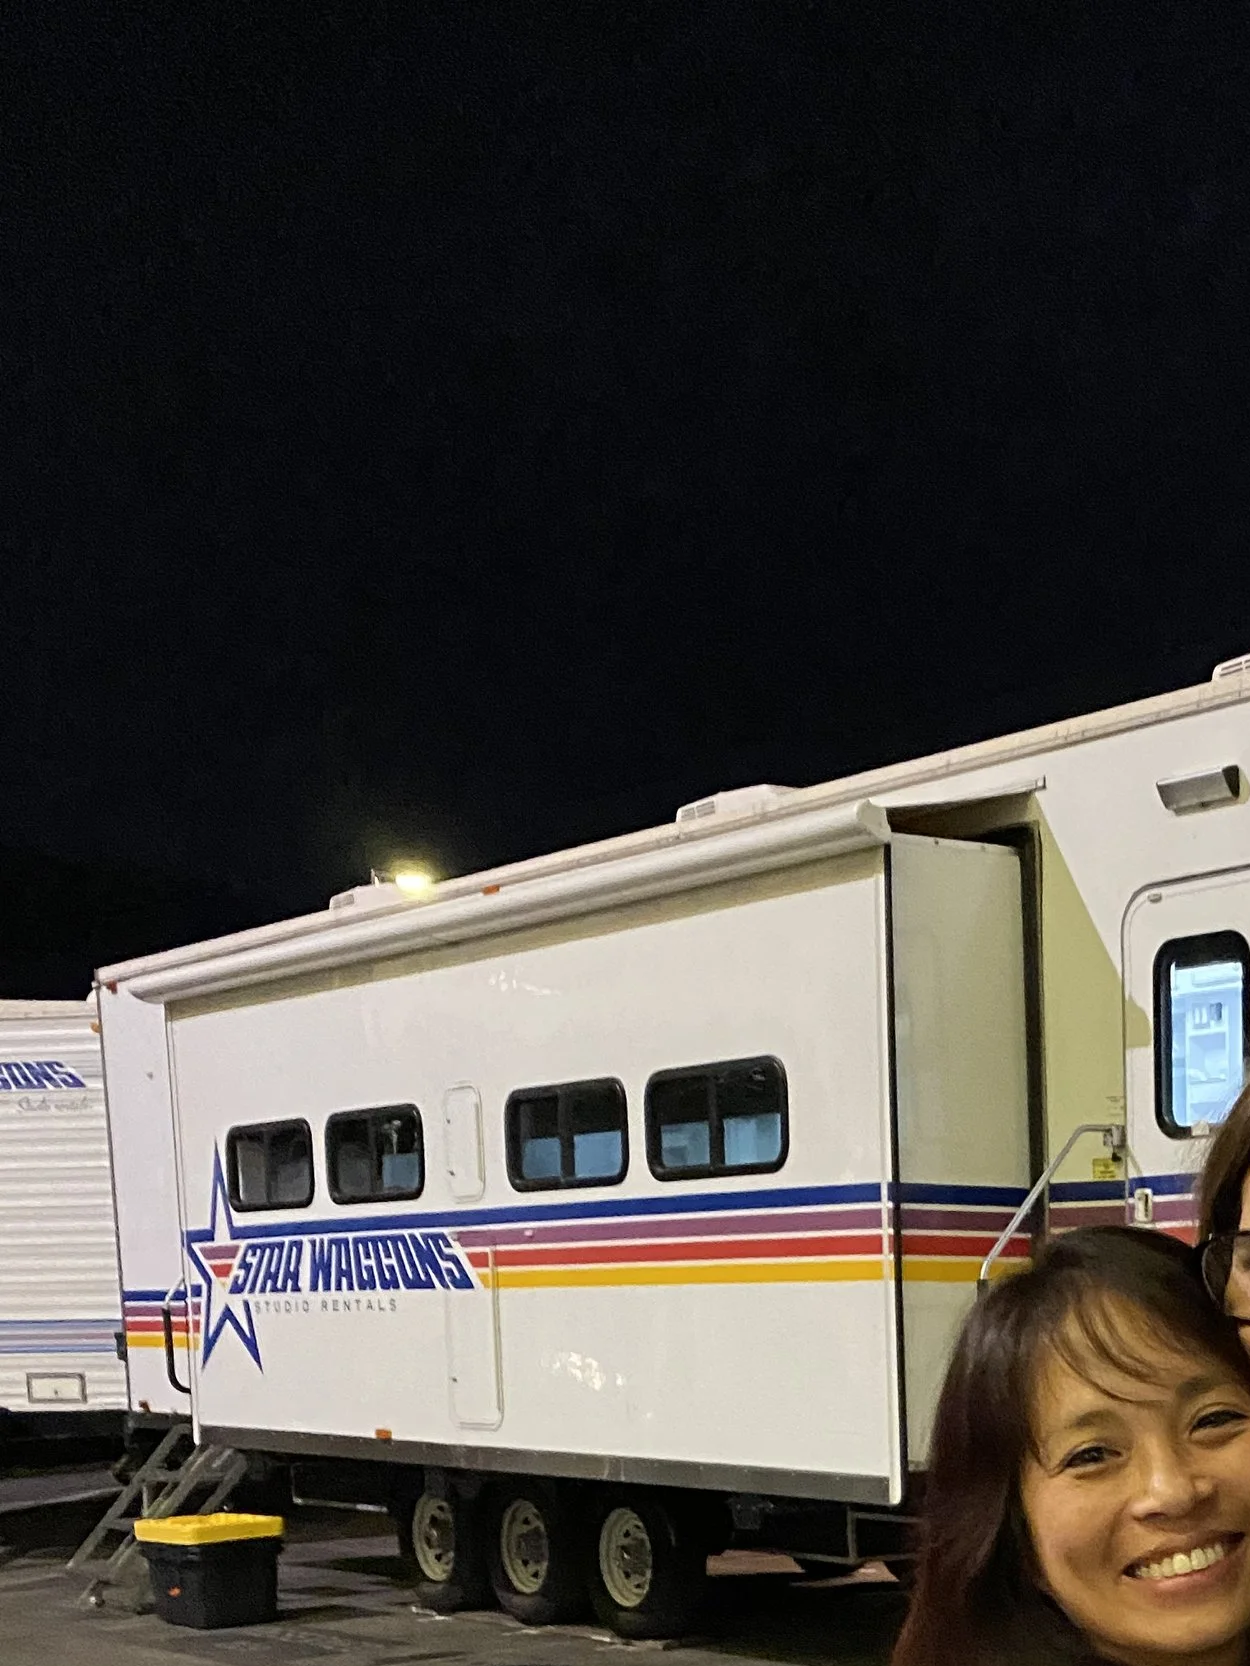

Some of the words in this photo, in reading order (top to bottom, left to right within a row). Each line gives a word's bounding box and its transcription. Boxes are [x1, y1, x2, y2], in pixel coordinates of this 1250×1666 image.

[228, 1239, 304, 1295] STAR
[308, 1231, 476, 1293] WAGGONS
[254, 1301, 310, 1315] STUDIO
[321, 1298, 398, 1313] RENTALS
